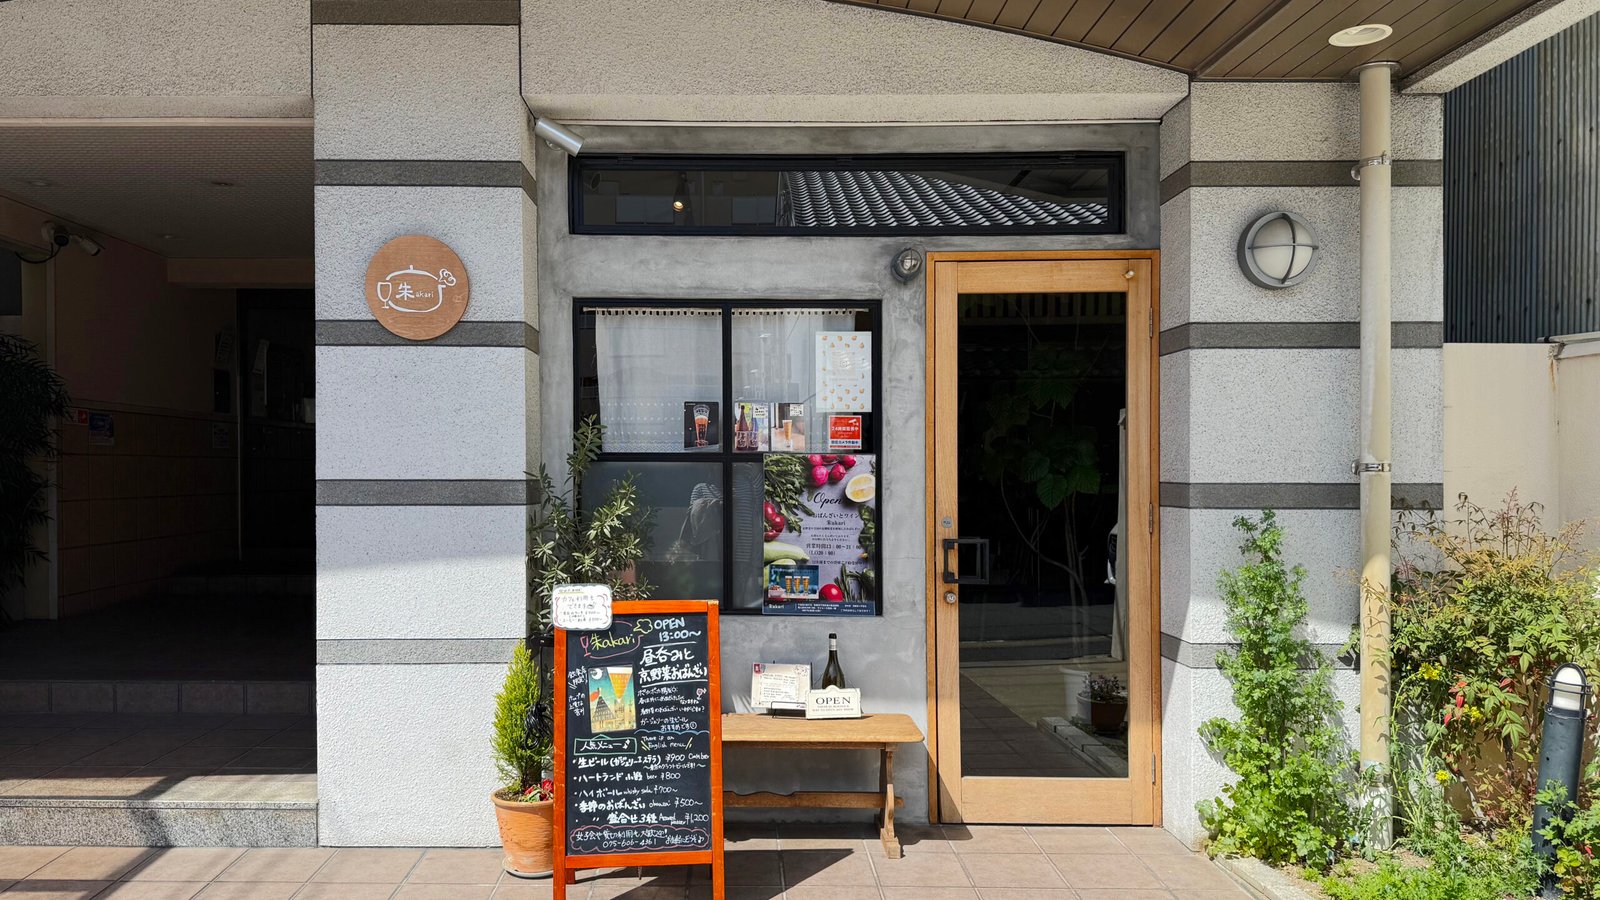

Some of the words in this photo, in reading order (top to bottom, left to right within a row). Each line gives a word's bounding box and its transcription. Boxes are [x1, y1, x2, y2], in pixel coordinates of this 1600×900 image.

[813, 492, 843, 509] Open
[654, 617, 686, 629] OPEN
[815, 696, 851, 705] OPEN
[660, 772, 681, 781] ¥800
[578, 788, 622, 798] ハイボール
